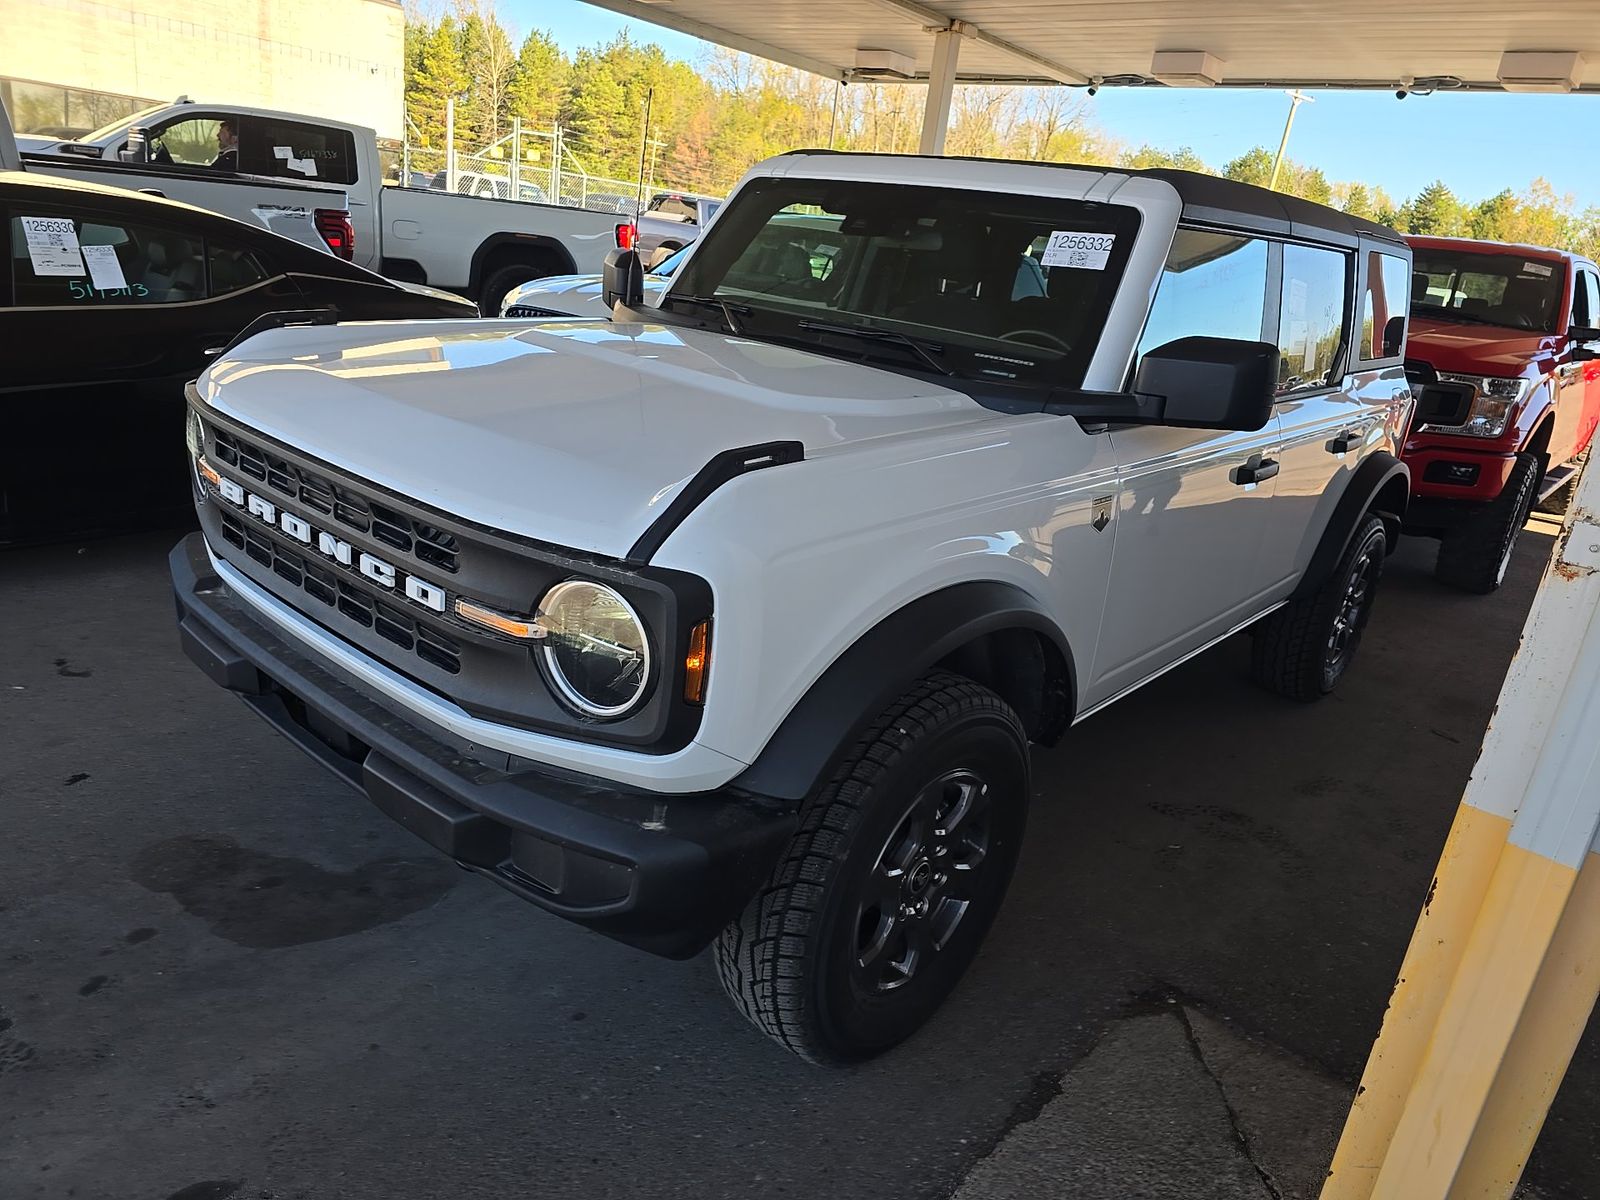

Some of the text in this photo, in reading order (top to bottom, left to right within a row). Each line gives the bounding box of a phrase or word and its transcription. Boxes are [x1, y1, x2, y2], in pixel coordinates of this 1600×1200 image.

[25, 220, 75, 233] 1256330
[1053, 235, 1114, 251] 1256332
[220, 476, 446, 613] BRONCO
